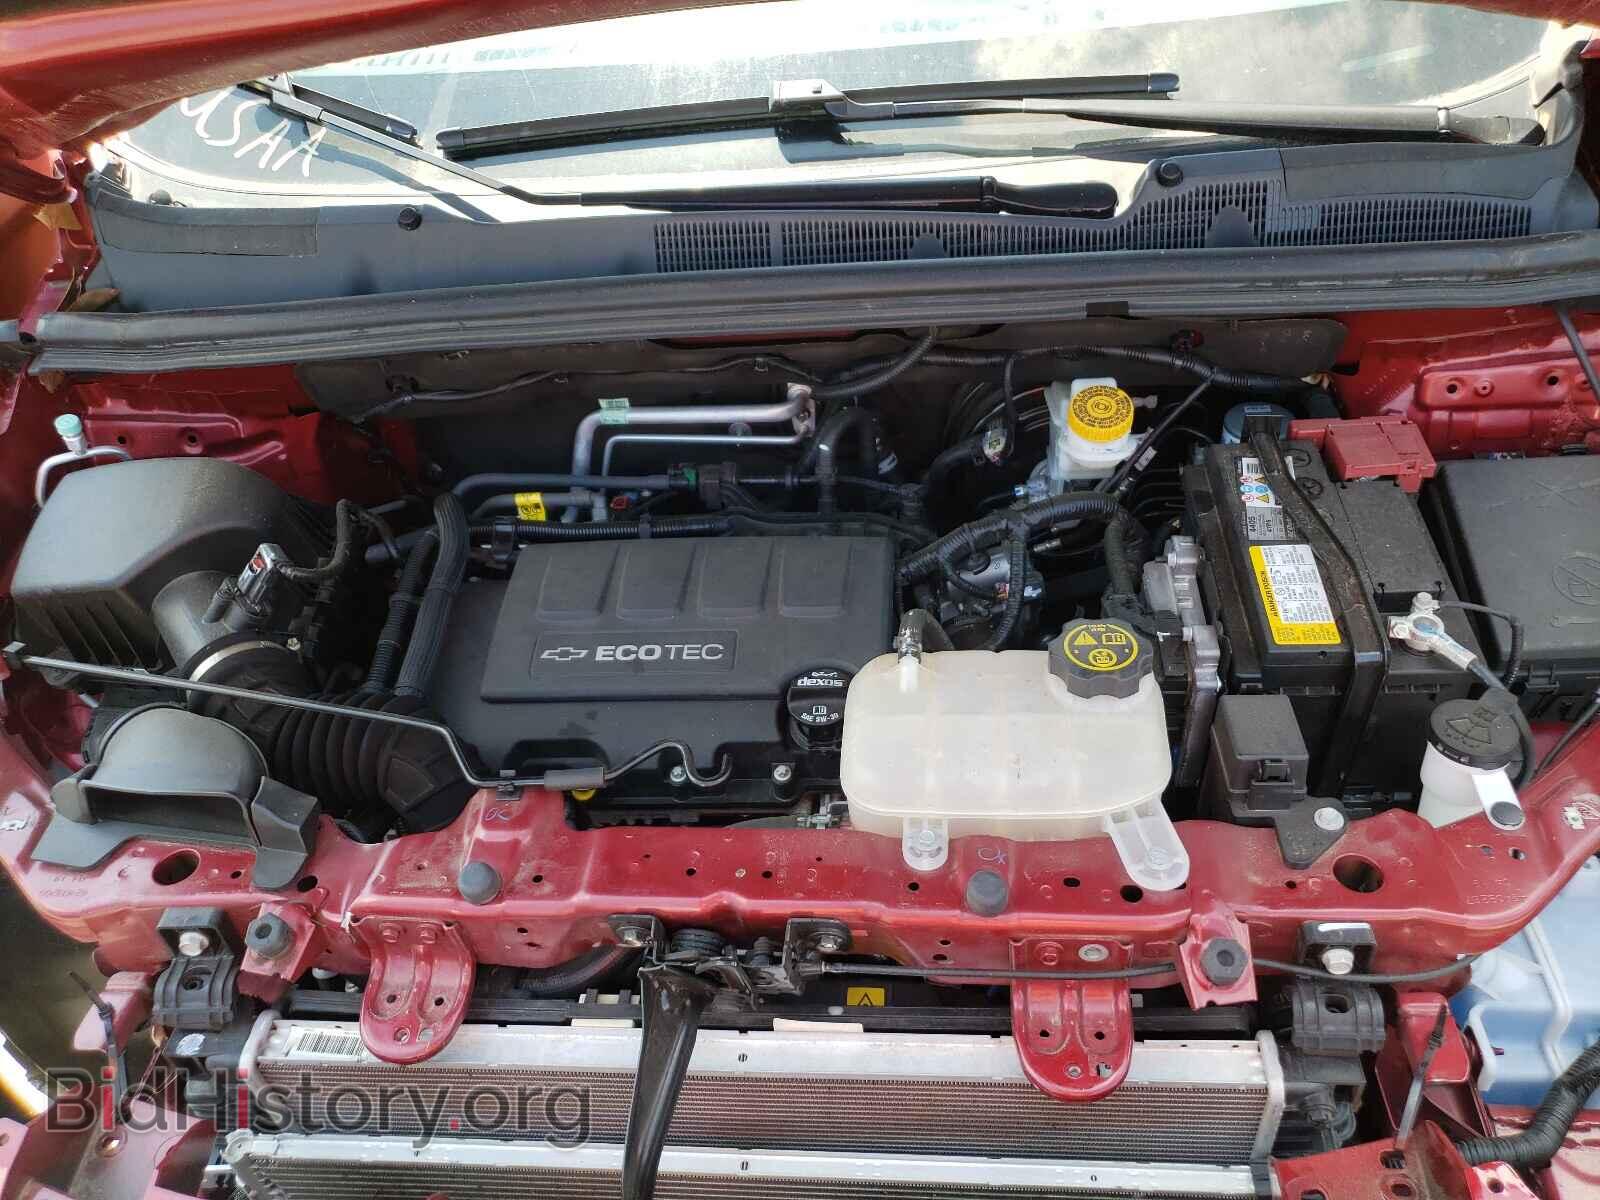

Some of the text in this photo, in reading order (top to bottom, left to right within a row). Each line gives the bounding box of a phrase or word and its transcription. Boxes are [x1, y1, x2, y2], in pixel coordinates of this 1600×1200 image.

[180, 86, 327, 177] USAA
[595, 643, 726, 661] ECOTEC
[797, 676, 845, 687] dexos
[801, 712, 815, 722] SAE
